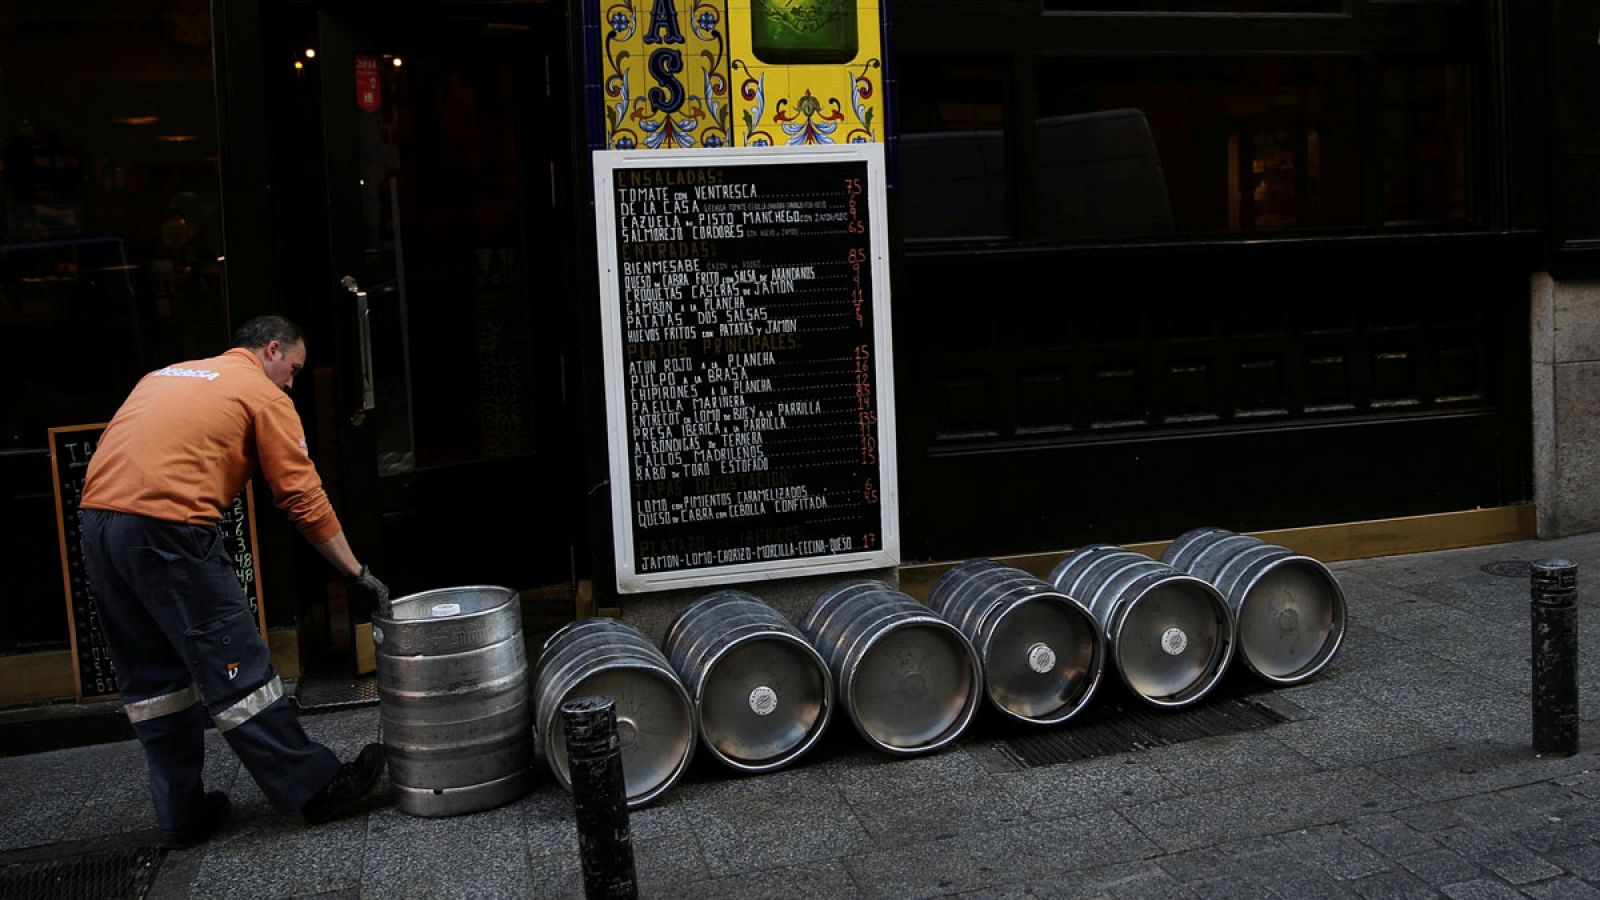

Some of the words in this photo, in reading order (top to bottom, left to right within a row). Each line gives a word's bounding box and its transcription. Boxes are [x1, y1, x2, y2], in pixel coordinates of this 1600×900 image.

[618, 187, 668, 203] TOMATE
[694, 184, 757, 200] VENTRESCA
[620, 202, 637, 216] DE
[643, 201, 656, 215] LA
[664, 200, 700, 215] CASA
[621, 215, 681, 229] CAZUELA
[698, 212, 734, 226] PISTO
[743, 209, 799, 225] MANCHEGO
[621, 227, 684, 243] SALMOREJO
[692, 224, 744, 240] CORDOBES
[624, 258, 701, 276] BIENMESABE
[624, 275, 652, 289] QUESO
[662, 273, 689, 287] CABRA
[695, 271, 719, 286] FRITO
[734, 269, 757, 284] SALSA
[771, 266, 816, 281] ARANDANOS
[625, 286, 683, 303] CROQUETAS
[691, 283, 740, 300] CASERAS
[754, 280, 795, 296] JAMON
[704, 296, 745, 311] PLANCHA
[627, 312, 683, 329] PATATAS
[697, 310, 718, 325] DOS
[726, 307, 768, 323] SALSAS
[628, 328, 660, 343] HUEVOS
[664, 326, 697, 340] FRITOS
[720, 322, 754, 338] PATATAS
[765, 319, 796, 335] JAMON
[629, 360, 657, 376] ATUN
[664, 357, 693, 373] ROJO
[728, 351, 776, 368] PLANCHA
[631, 372, 676, 389] PULPO
[707, 366, 748, 383] BRASA
[631, 384, 698, 402] CHIPIRONES
[733, 378, 773, 395] PLANCHA
[632, 399, 685, 416] PAELLA
[692, 395, 745, 411] MARINERA
[632, 412, 681, 429] ENTRECOT
[694, 408, 720, 424] LOMO
[733, 404, 756, 420] BUEY
[778, 400, 821, 416] PARRILLA
[633, 425, 673, 442] PRESA
[681, 422, 721, 437] IBERICA
[744, 415, 786, 432] PARRILLA
[635, 436, 701, 454] ALBONDIGAS
[721, 431, 763, 448] TERNERA
[635, 451, 682, 469] CALLOS
[636, 466, 666, 481] RABO
[682, 462, 710, 478] TORO
[721, 456, 769, 474] ESTOFADO
[637, 498, 667, 513] LOMO
[684, 492, 732, 509] PIMIENTOS
[737, 484, 807, 504] CARAMELIZADOS
[638, 512, 671, 529] QUESO
[681, 507, 713, 523] CABRA
[728, 501, 766, 518] CEBOLLA
[775, 495, 828, 513] CONFITADA
[235, 523, 243, 536] 6
[237, 538, 246, 553] 3
[235, 552, 252, 568] 48
[236, 568, 253, 583] 48
